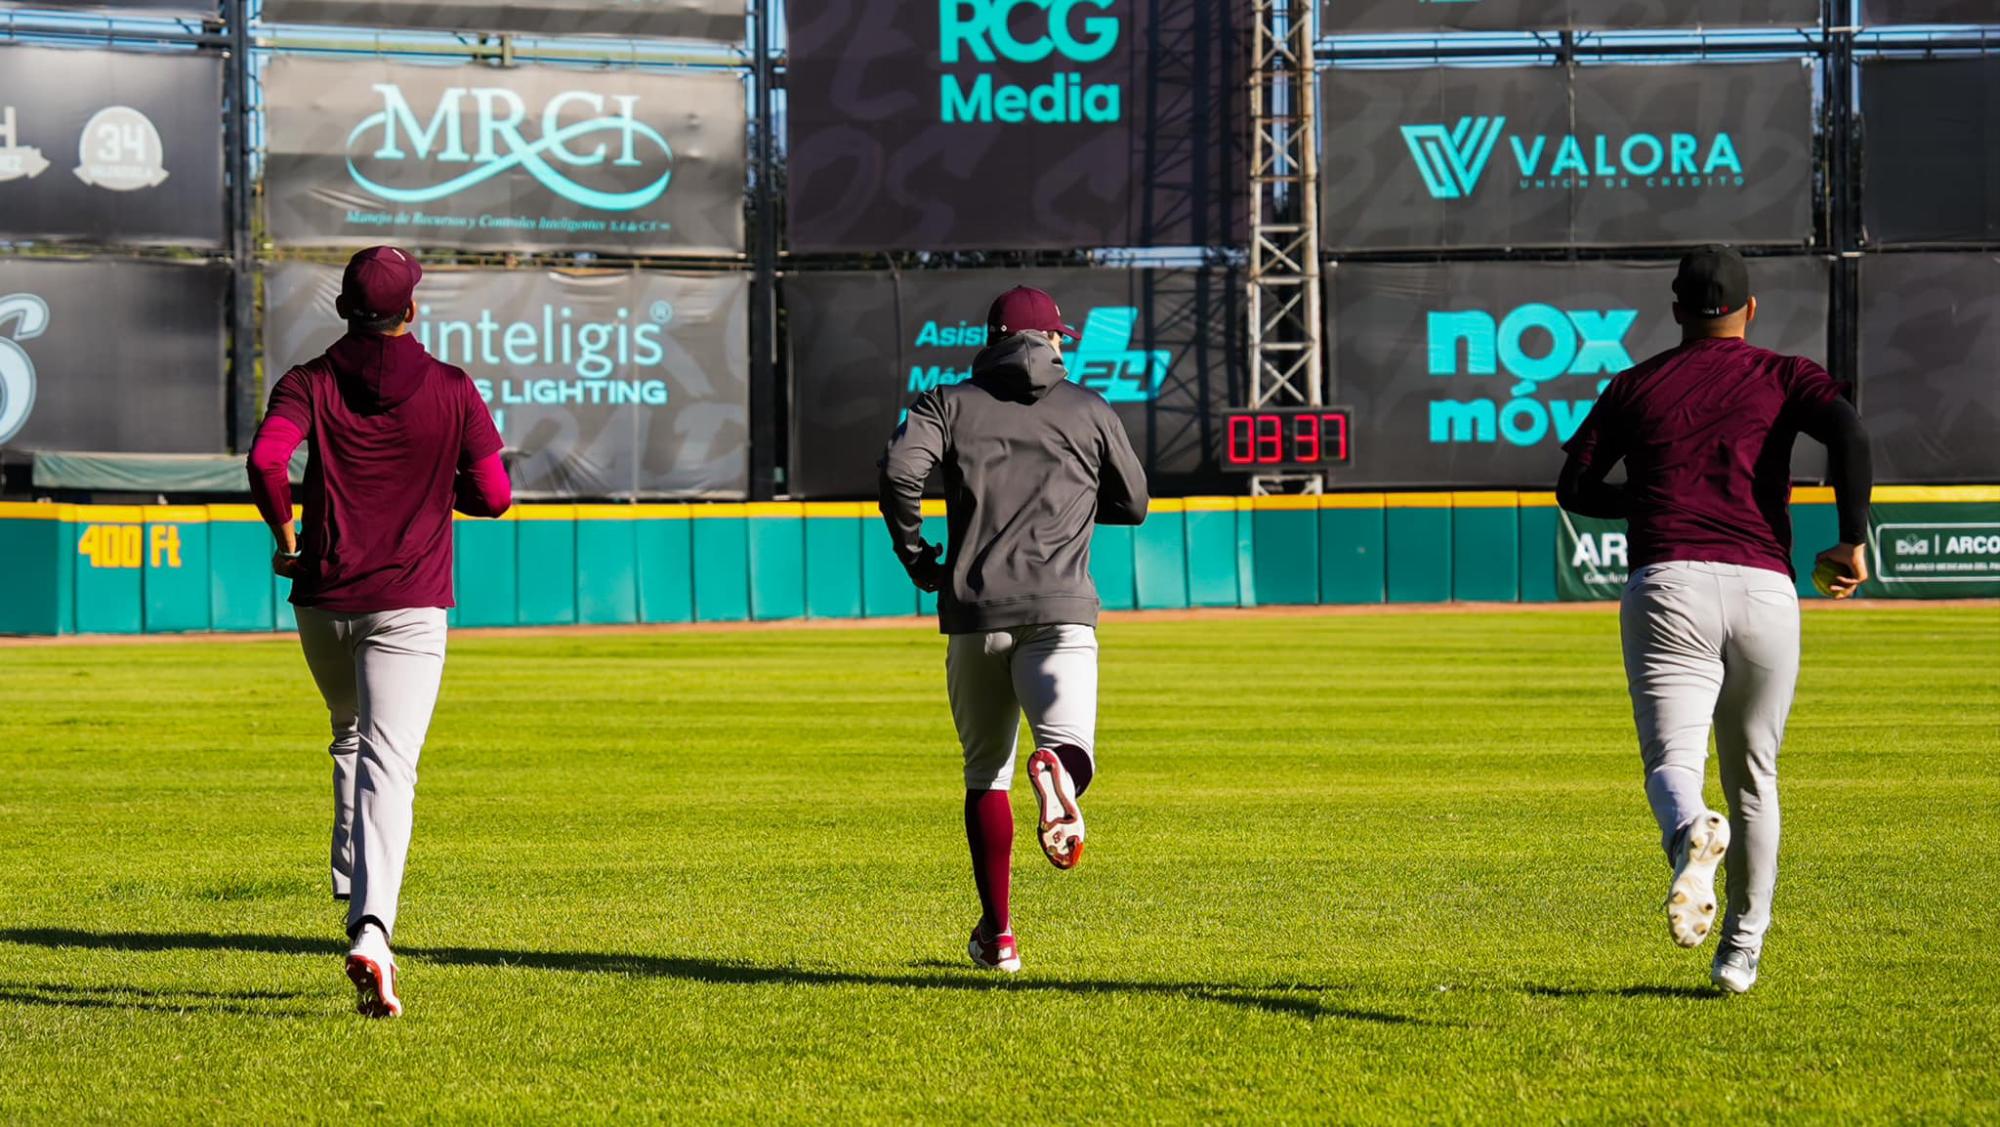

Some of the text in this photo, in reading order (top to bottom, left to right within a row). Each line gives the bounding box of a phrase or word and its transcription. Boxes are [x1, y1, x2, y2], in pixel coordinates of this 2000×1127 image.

[940, 0, 1120, 63] RCG
[940, 72, 1121, 123] Media
[97, 123, 145, 162] 34
[372, 84, 641, 166] MRCI
[1509, 133, 1743, 176] VALORA
[1604, 178, 1629, 189] DE
[345, 209, 392, 227] Manejo
[1427, 303, 1638, 381] nox
[502, 378, 668, 404] LIGHTING
[78, 524, 143, 568] 400
[1945, 534, 2000, 555] ARCO
